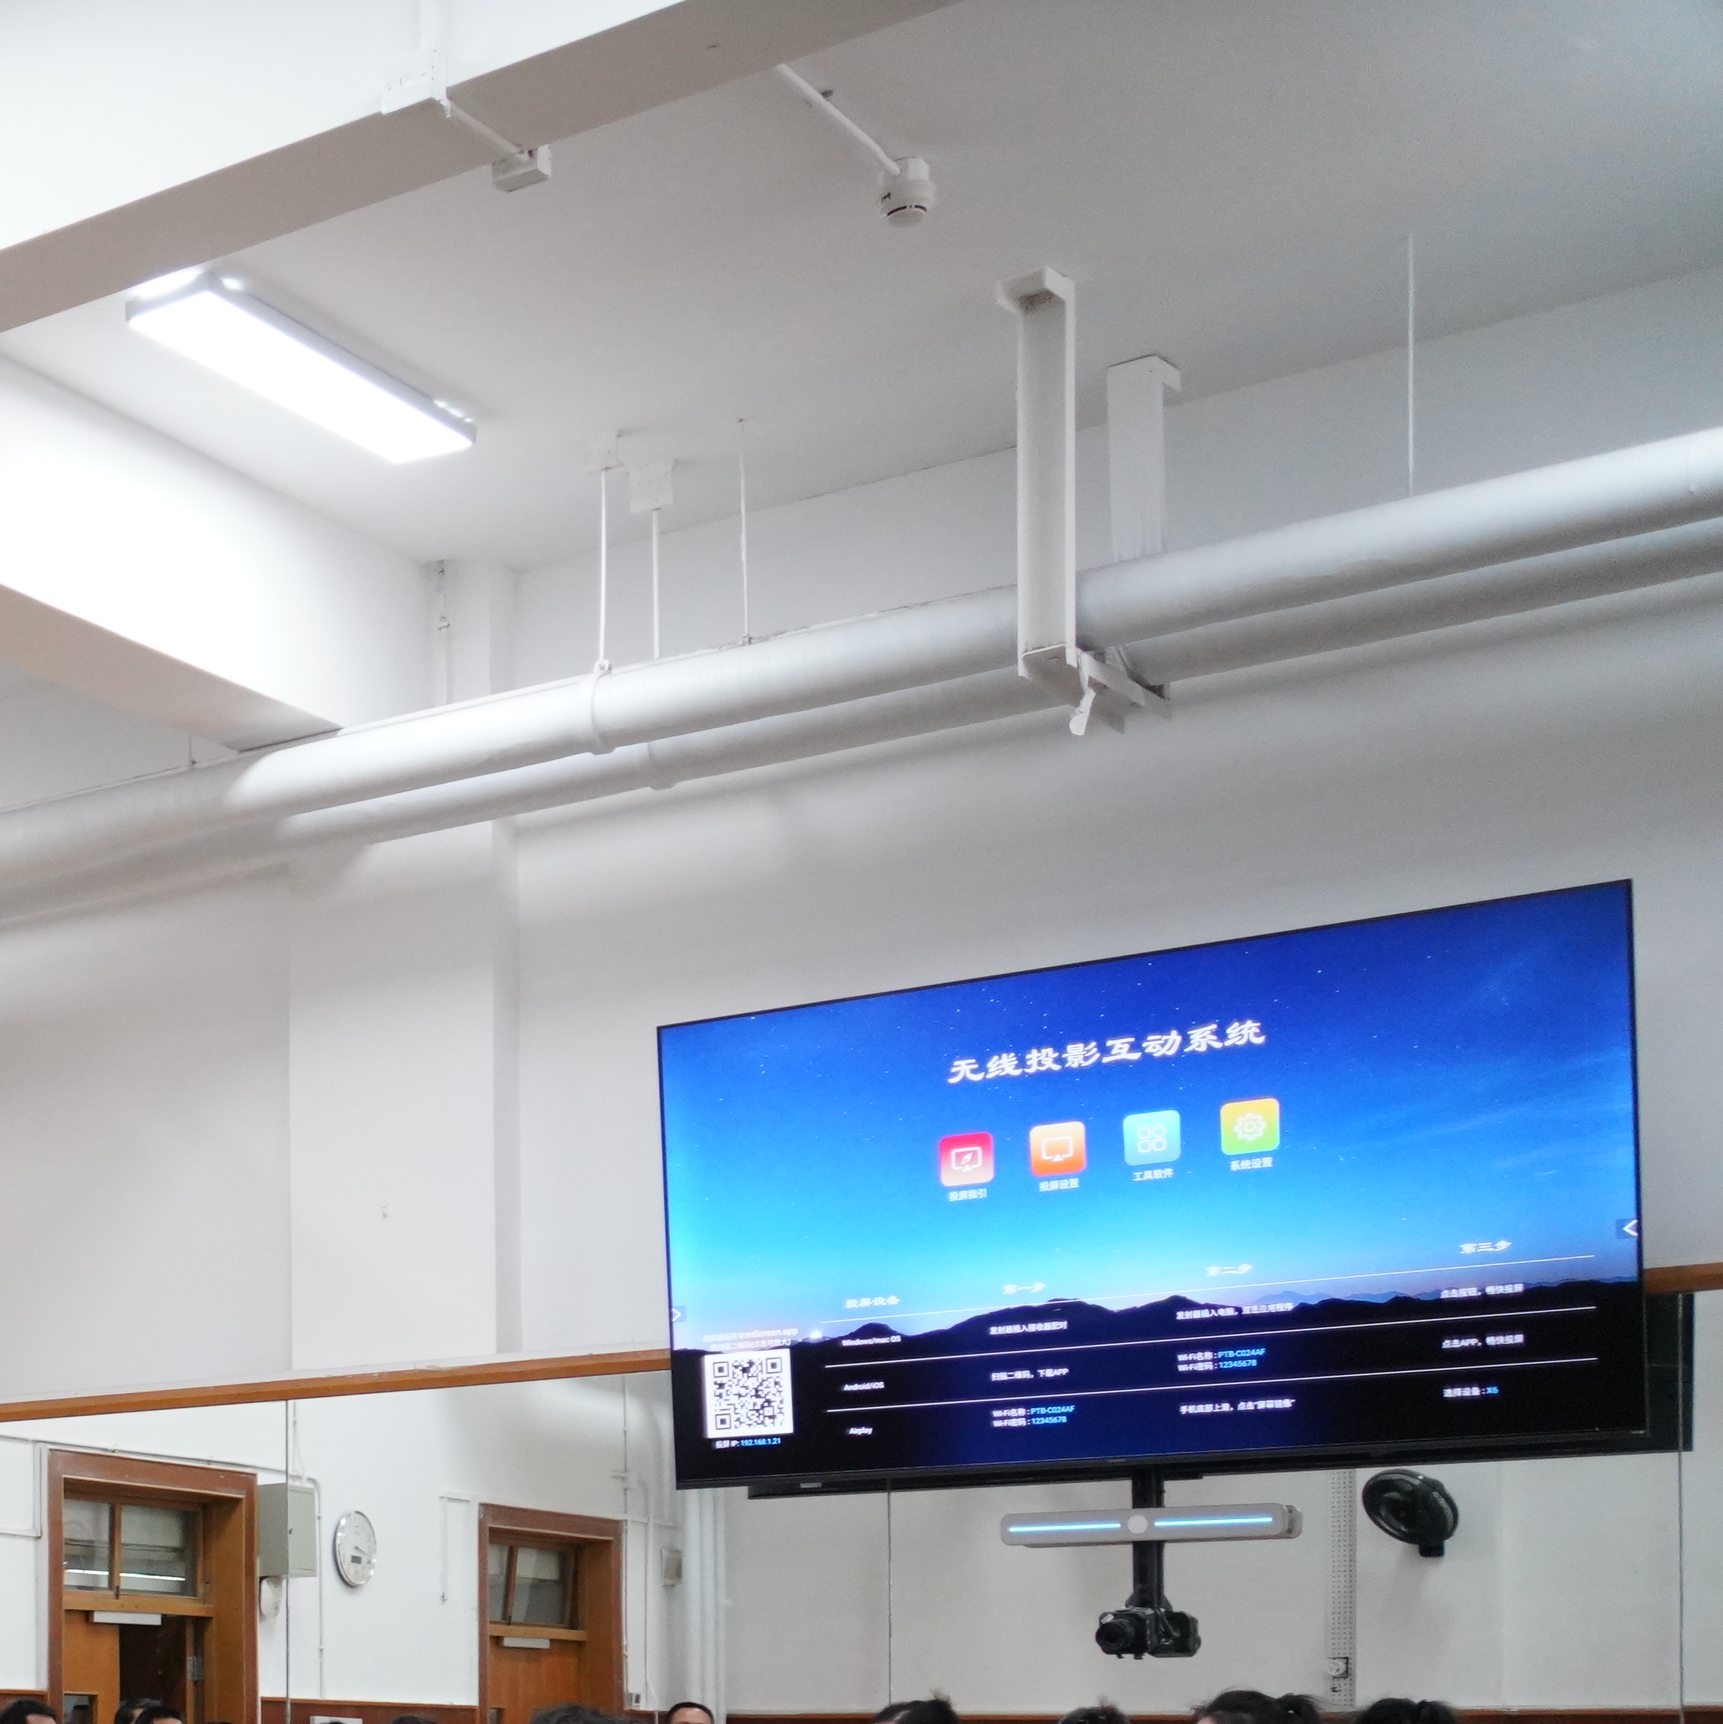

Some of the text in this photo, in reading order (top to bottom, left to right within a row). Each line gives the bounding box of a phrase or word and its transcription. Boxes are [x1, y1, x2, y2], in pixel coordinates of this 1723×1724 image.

[947, 1018, 1267, 1085] 无线投影互动系统
[1229, 1156, 1273, 1172] 系统设置
[1132, 1167, 1174, 1183] 工具软件
[1038, 1177, 1080, 1193] 投屏设置
[948, 1187, 988, 1203] 投屏指引
